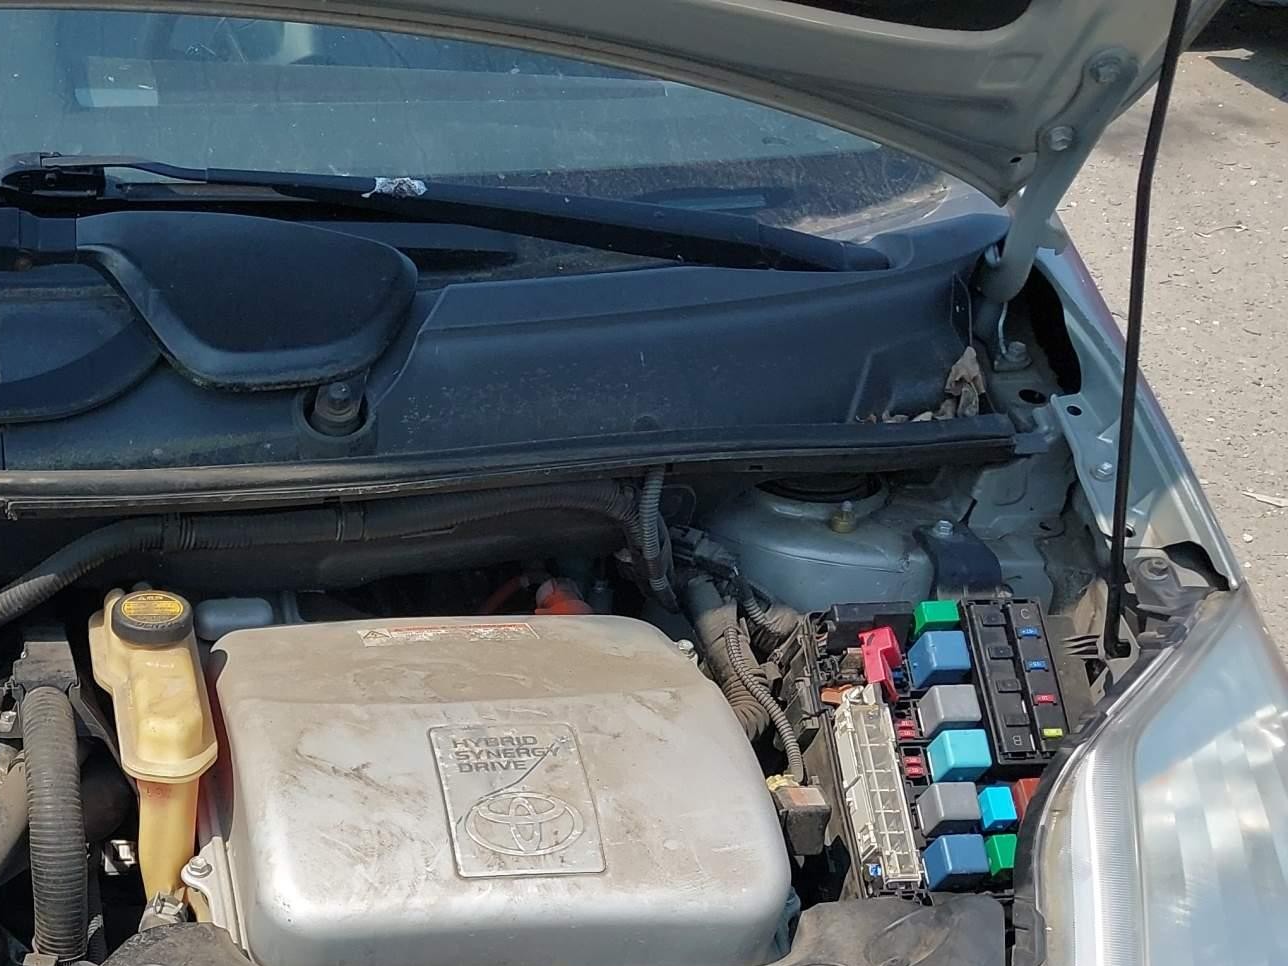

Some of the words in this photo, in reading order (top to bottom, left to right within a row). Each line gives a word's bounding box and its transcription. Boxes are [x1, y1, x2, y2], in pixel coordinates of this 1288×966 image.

[452, 735, 538, 749] HYBRID
[455, 746, 561, 761] SYNERGY
[458, 759, 528, 773] DRIVE
